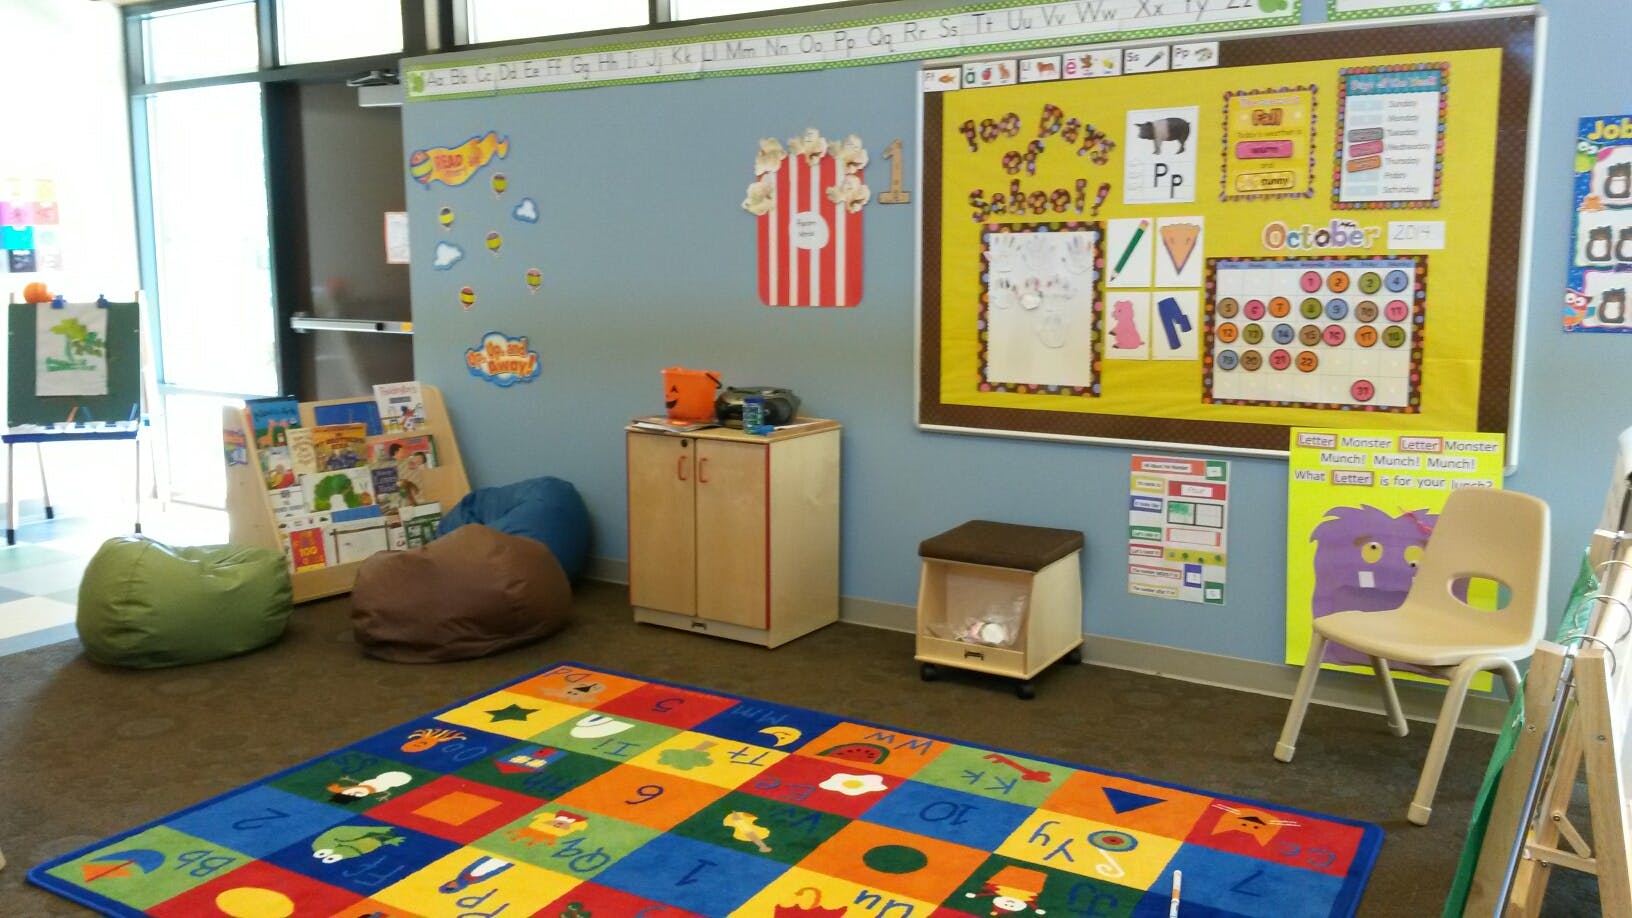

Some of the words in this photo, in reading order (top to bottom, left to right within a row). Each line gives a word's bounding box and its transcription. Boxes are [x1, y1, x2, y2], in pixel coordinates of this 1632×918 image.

[673, 47, 691, 64] Kk
[726, 40, 755, 60] Mm
[765, 37, 788, 57] Nn
[800, 34, 822, 54] Oo
[834, 30, 856, 58] Pp
[867, 26, 895, 53] Qq
[903, 21, 926, 42] Rr
[938, 17, 957, 38] Ss
[971, 13, 993, 35] Tt
[1007, 9, 1032, 31] Uu
[1041, 5, 1066, 27] Vv
[1076, 1, 1117, 24] Ww
[959, 112, 1021, 152] 100
[1038, 103, 1116, 166] Days
[878, 138, 911, 204] 1
[1002, 139, 1045, 176] of
[1154, 163, 1183, 198] Pp
[1264, 220, 1382, 248] October
[1299, 434, 1333, 447] Letter
[1341, 437, 1391, 448] Monster
[1402, 438, 1438, 450] Letter
[1445, 440, 1497, 451] Monster
[1320, 452, 1365, 464] Munch!
[1374, 455, 1420, 466] Munch!
[1427, 457, 1475, 469] Munch!
[1295, 470, 1325, 481] What
[1335, 473, 1370, 484] Letter
[1380, 475, 1389, 486] is
[1394, 474, 1411, 486] for
[1417, 478, 1445, 489] your
[728, 746, 771, 767] Tt
[863, 730, 934, 757] Ww
[961, 768, 1019, 795] Kk
[231, 807, 291, 832] 2
[919, 801, 982, 827] 10
[1028, 821, 1075, 863] Yy
[168, 849, 237, 878] Bb
